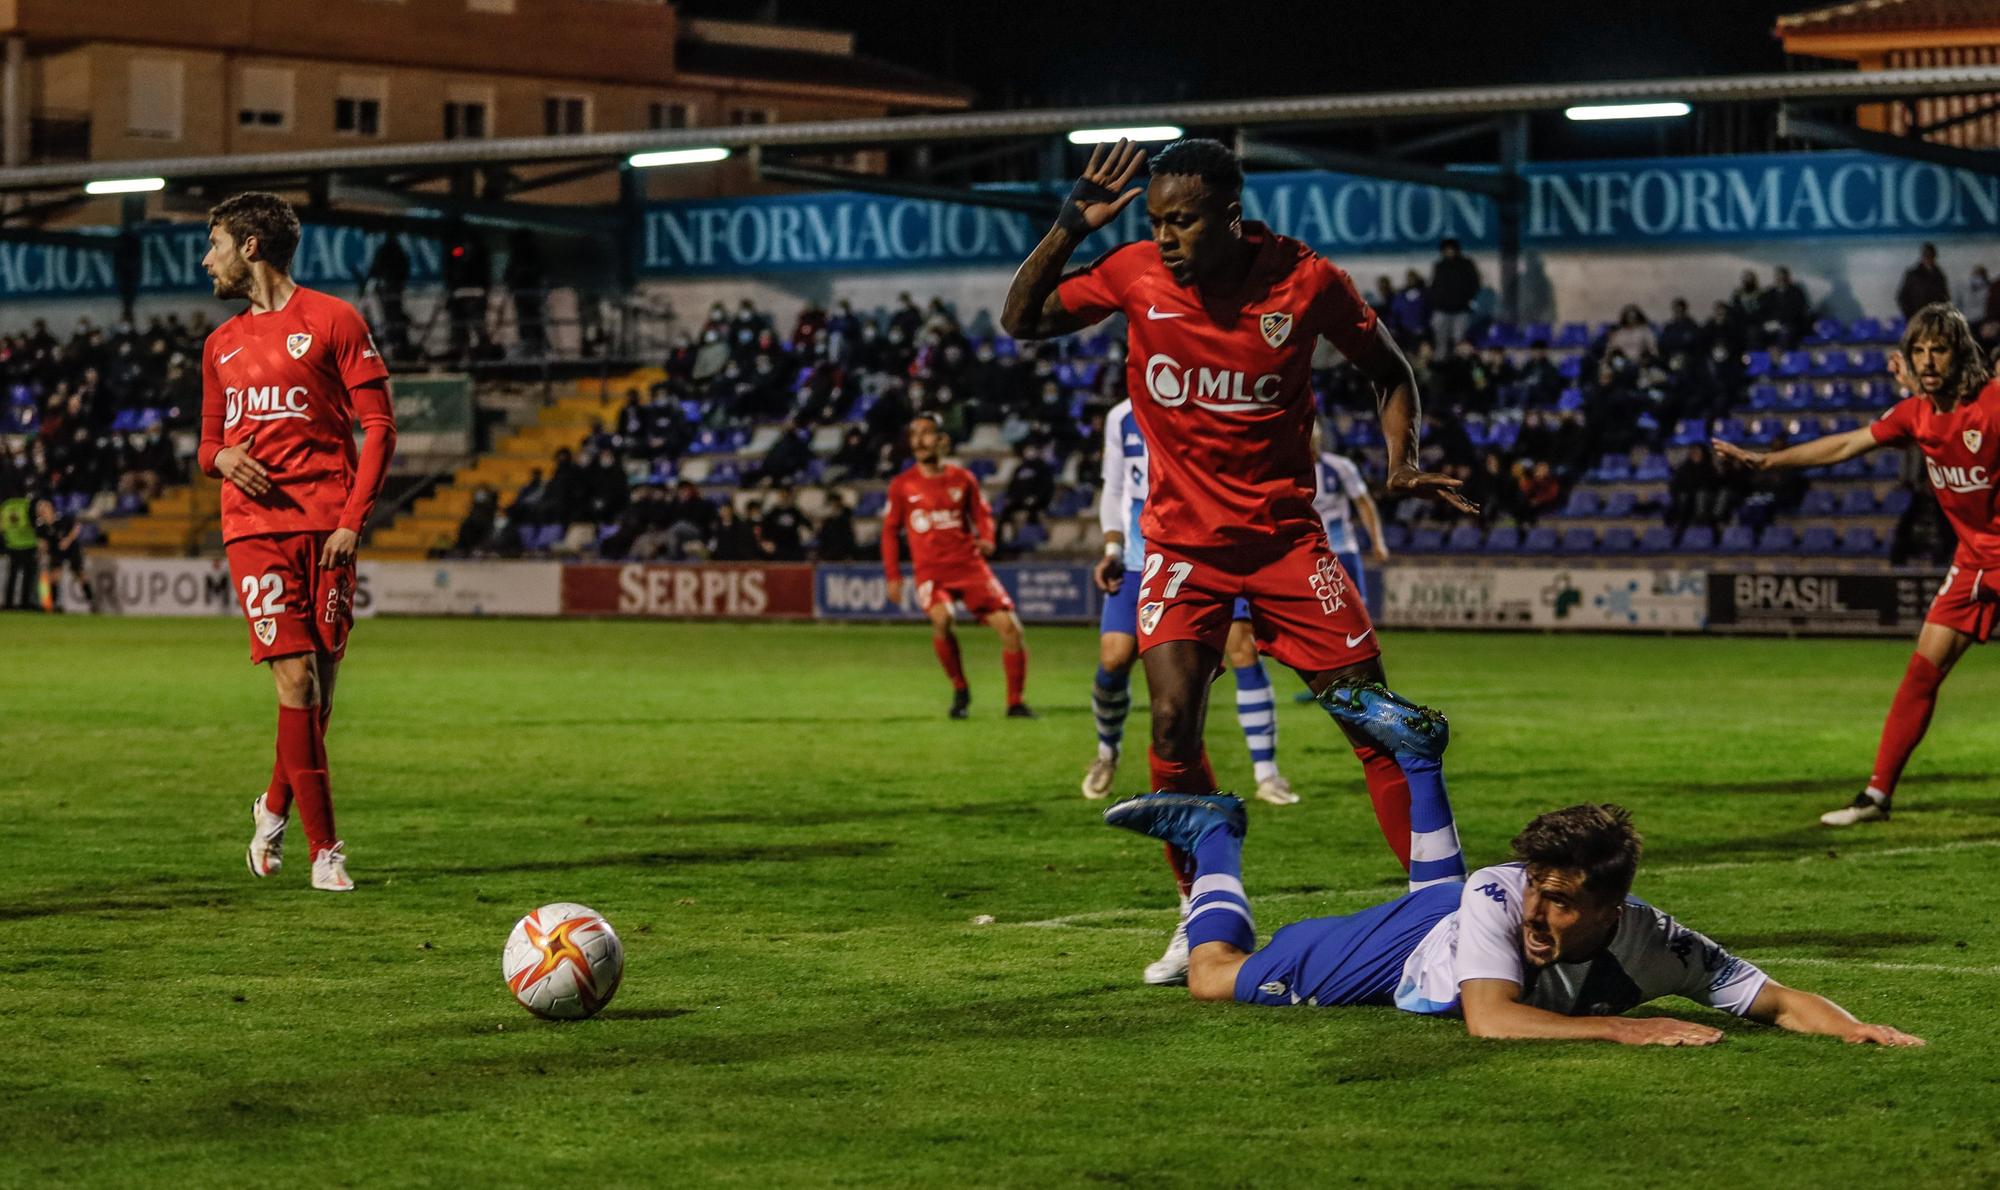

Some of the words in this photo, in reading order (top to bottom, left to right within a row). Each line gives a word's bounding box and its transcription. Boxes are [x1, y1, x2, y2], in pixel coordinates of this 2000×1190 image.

[1528, 160, 2000, 237] INFORMACION
[643, 199, 1028, 267] INFORMACION
[247, 386, 309, 412] MLC
[1197, 367, 1282, 402] MLC
[1942, 465, 1989, 486] MLC
[241, 573, 286, 618] 22
[618, 563, 768, 615] SERPIS
[1139, 553, 1194, 599] 27
[1734, 574, 1847, 614] BRASIL
